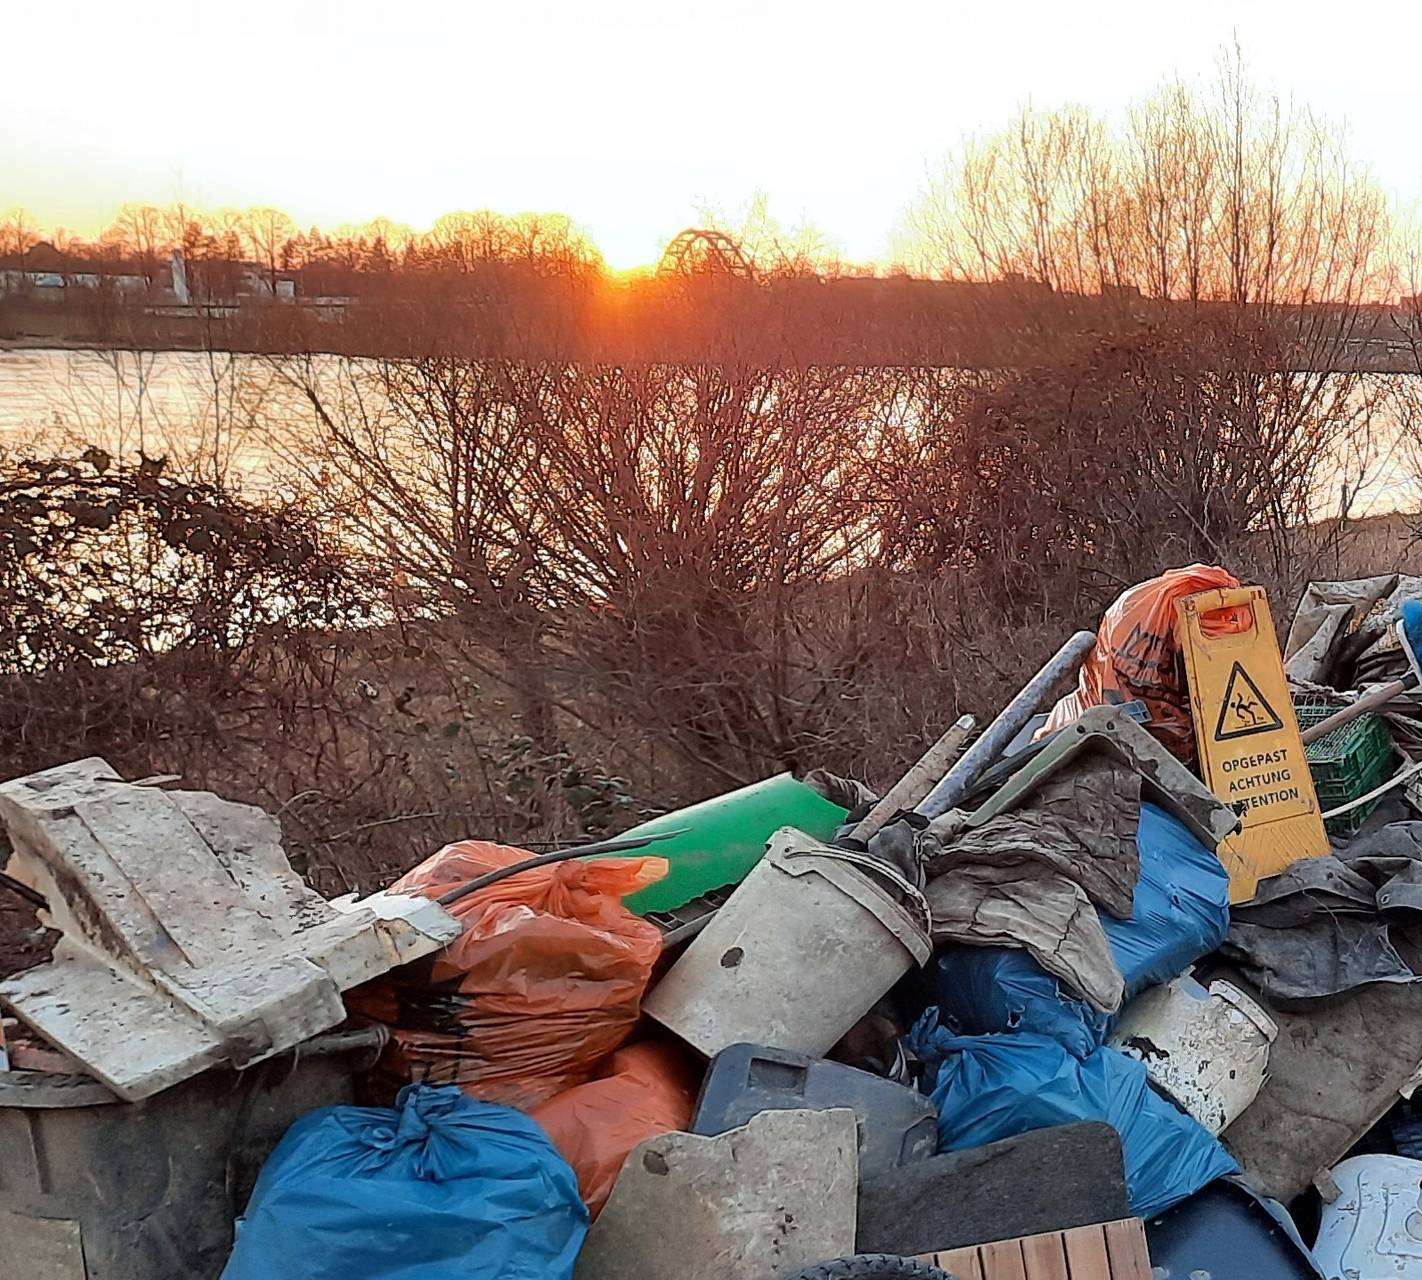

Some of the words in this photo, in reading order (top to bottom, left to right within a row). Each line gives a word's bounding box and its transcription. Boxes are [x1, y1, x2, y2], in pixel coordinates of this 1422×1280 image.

[1222, 749, 1287, 773] OPGEPAST
[1229, 769, 1291, 793] ACHTUNG
[1227, 787, 1299, 813] TENTION
